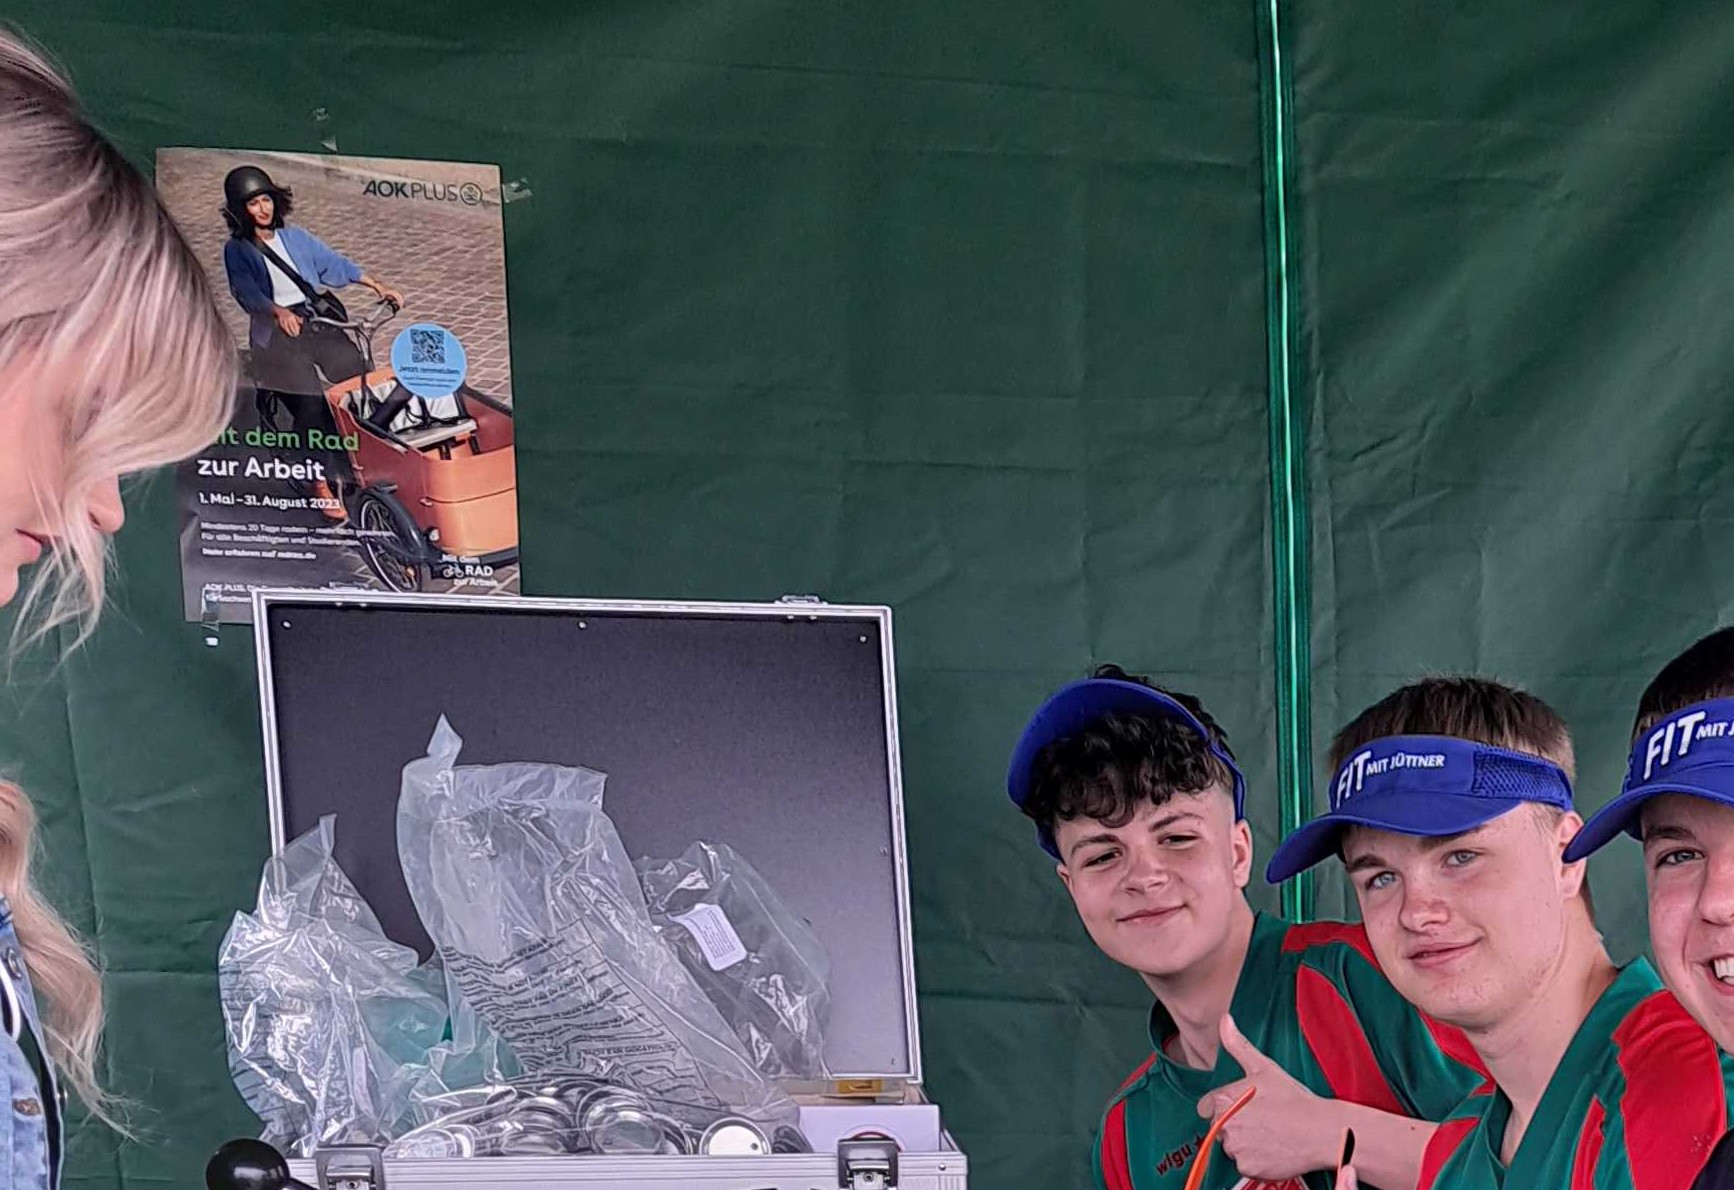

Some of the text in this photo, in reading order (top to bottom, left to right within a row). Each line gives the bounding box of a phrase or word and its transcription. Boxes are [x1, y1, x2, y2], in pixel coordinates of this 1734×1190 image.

[244, 426, 300, 449] dem
[307, 428, 360, 451] Rad
[197, 456, 326, 481] zur Arbeit
[210, 493, 235, 506] Mai
[262, 496, 308, 511] August
[465, 565, 494, 577] RAD
[1642, 710, 1707, 781] FIT
[1695, 721, 1728, 740] MIT
[1335, 750, 1372, 810] FIT
[1366, 758, 1391, 777] MIT
